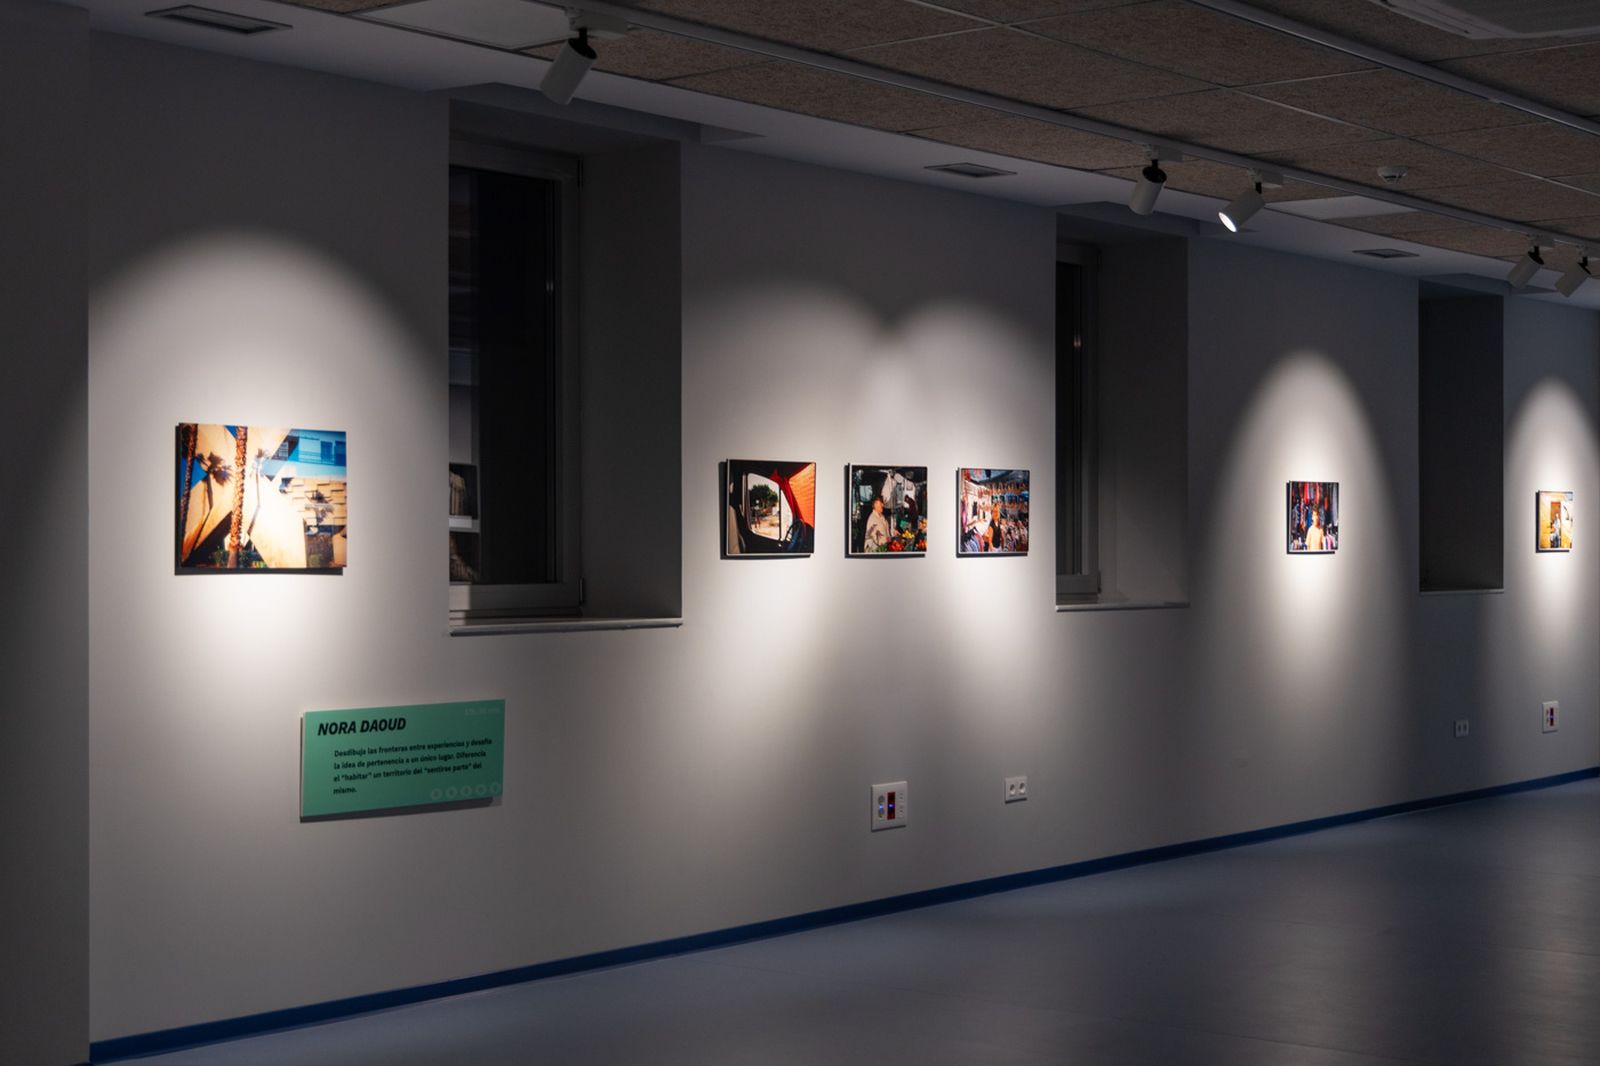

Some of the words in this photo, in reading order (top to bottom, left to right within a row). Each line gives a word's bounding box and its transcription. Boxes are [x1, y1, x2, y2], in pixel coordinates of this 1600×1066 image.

[317, 721, 357, 736] NORA
[360, 717, 407, 733] DAOUD
[334, 747, 366, 757] Desdibuja
[379, 745, 408, 754] fronteras
[427, 740, 465, 751] experiencias
[357, 760, 365, 768] de
[366, 757, 404, 768] pertenencia
[456, 750, 486, 759] Diferencia
[333, 774, 340, 782] el
[383, 768, 412, 778] territorio
[413, 767, 422, 775] del
